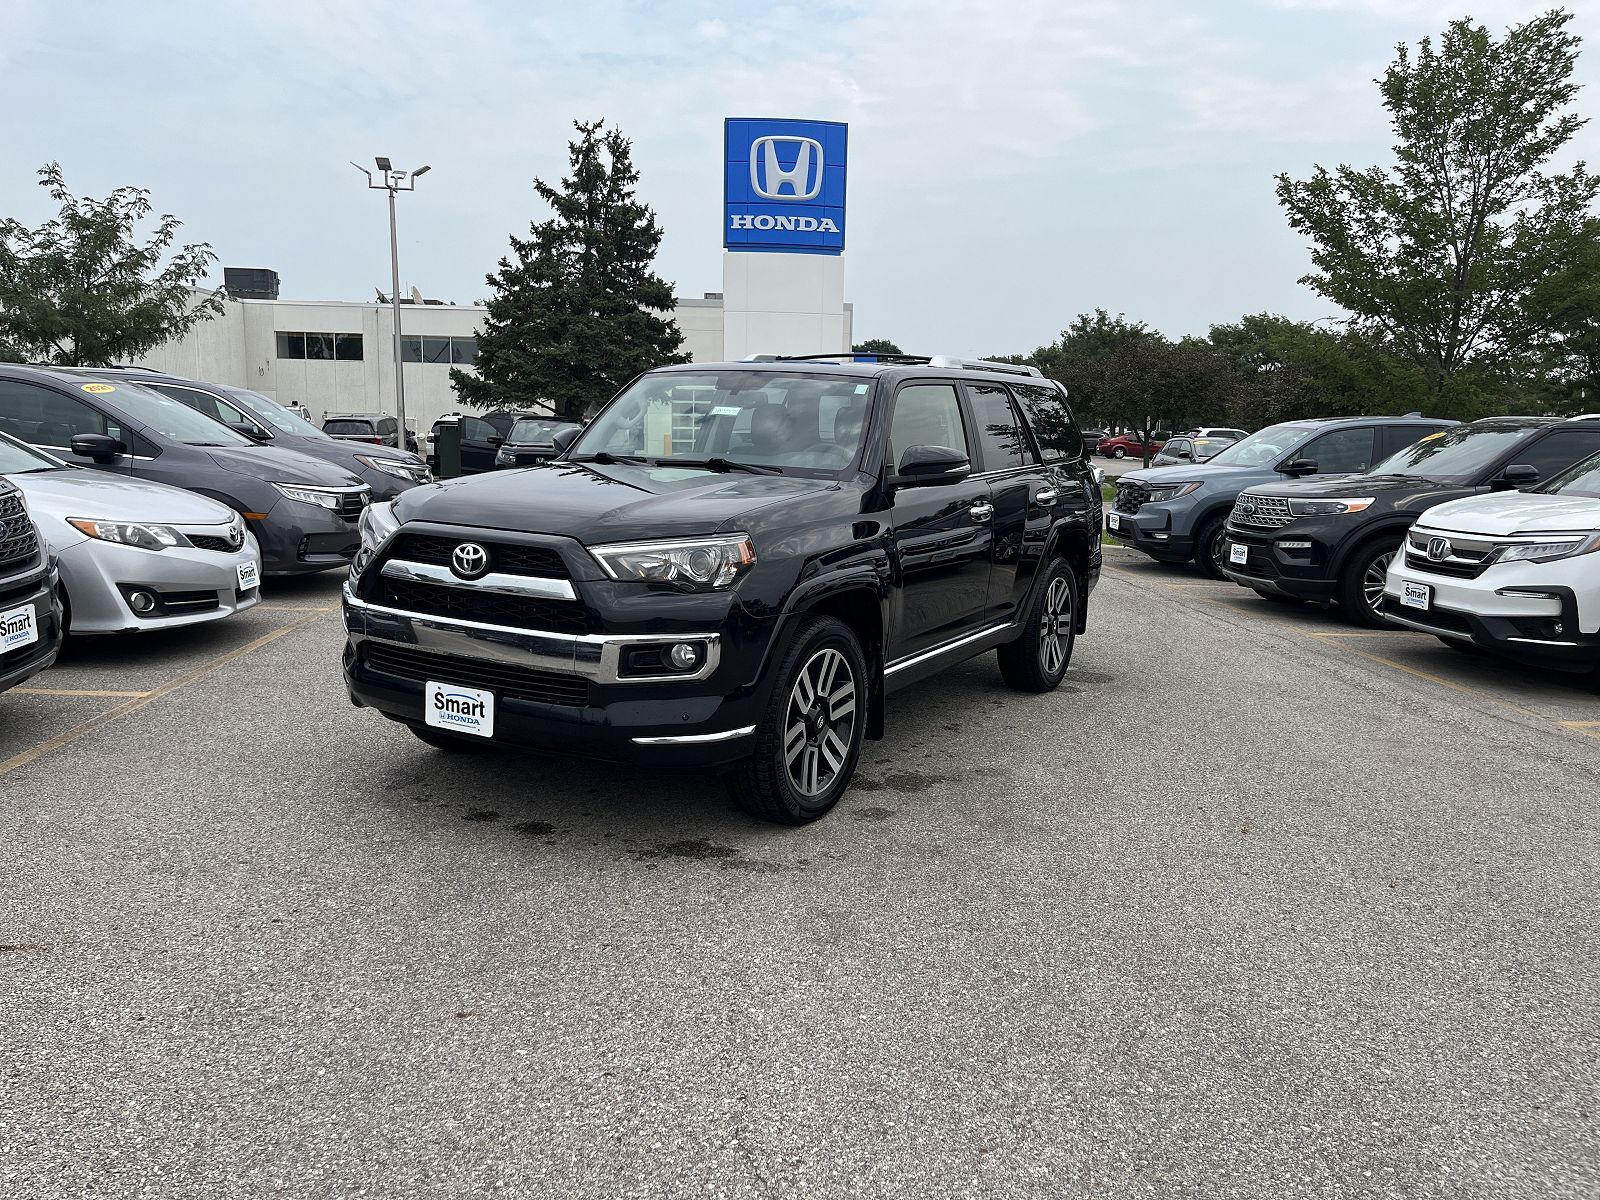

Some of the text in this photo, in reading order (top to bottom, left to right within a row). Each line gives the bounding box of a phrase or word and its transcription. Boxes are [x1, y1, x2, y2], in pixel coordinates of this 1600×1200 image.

[730, 214, 840, 233] HONDA
[1405, 586, 1427, 601] Smart
[0, 613, 31, 637] Smart
[10, 630, 30, 642] HONDA
[434, 691, 486, 719] Smart
[446, 713, 481, 726] HONDA
